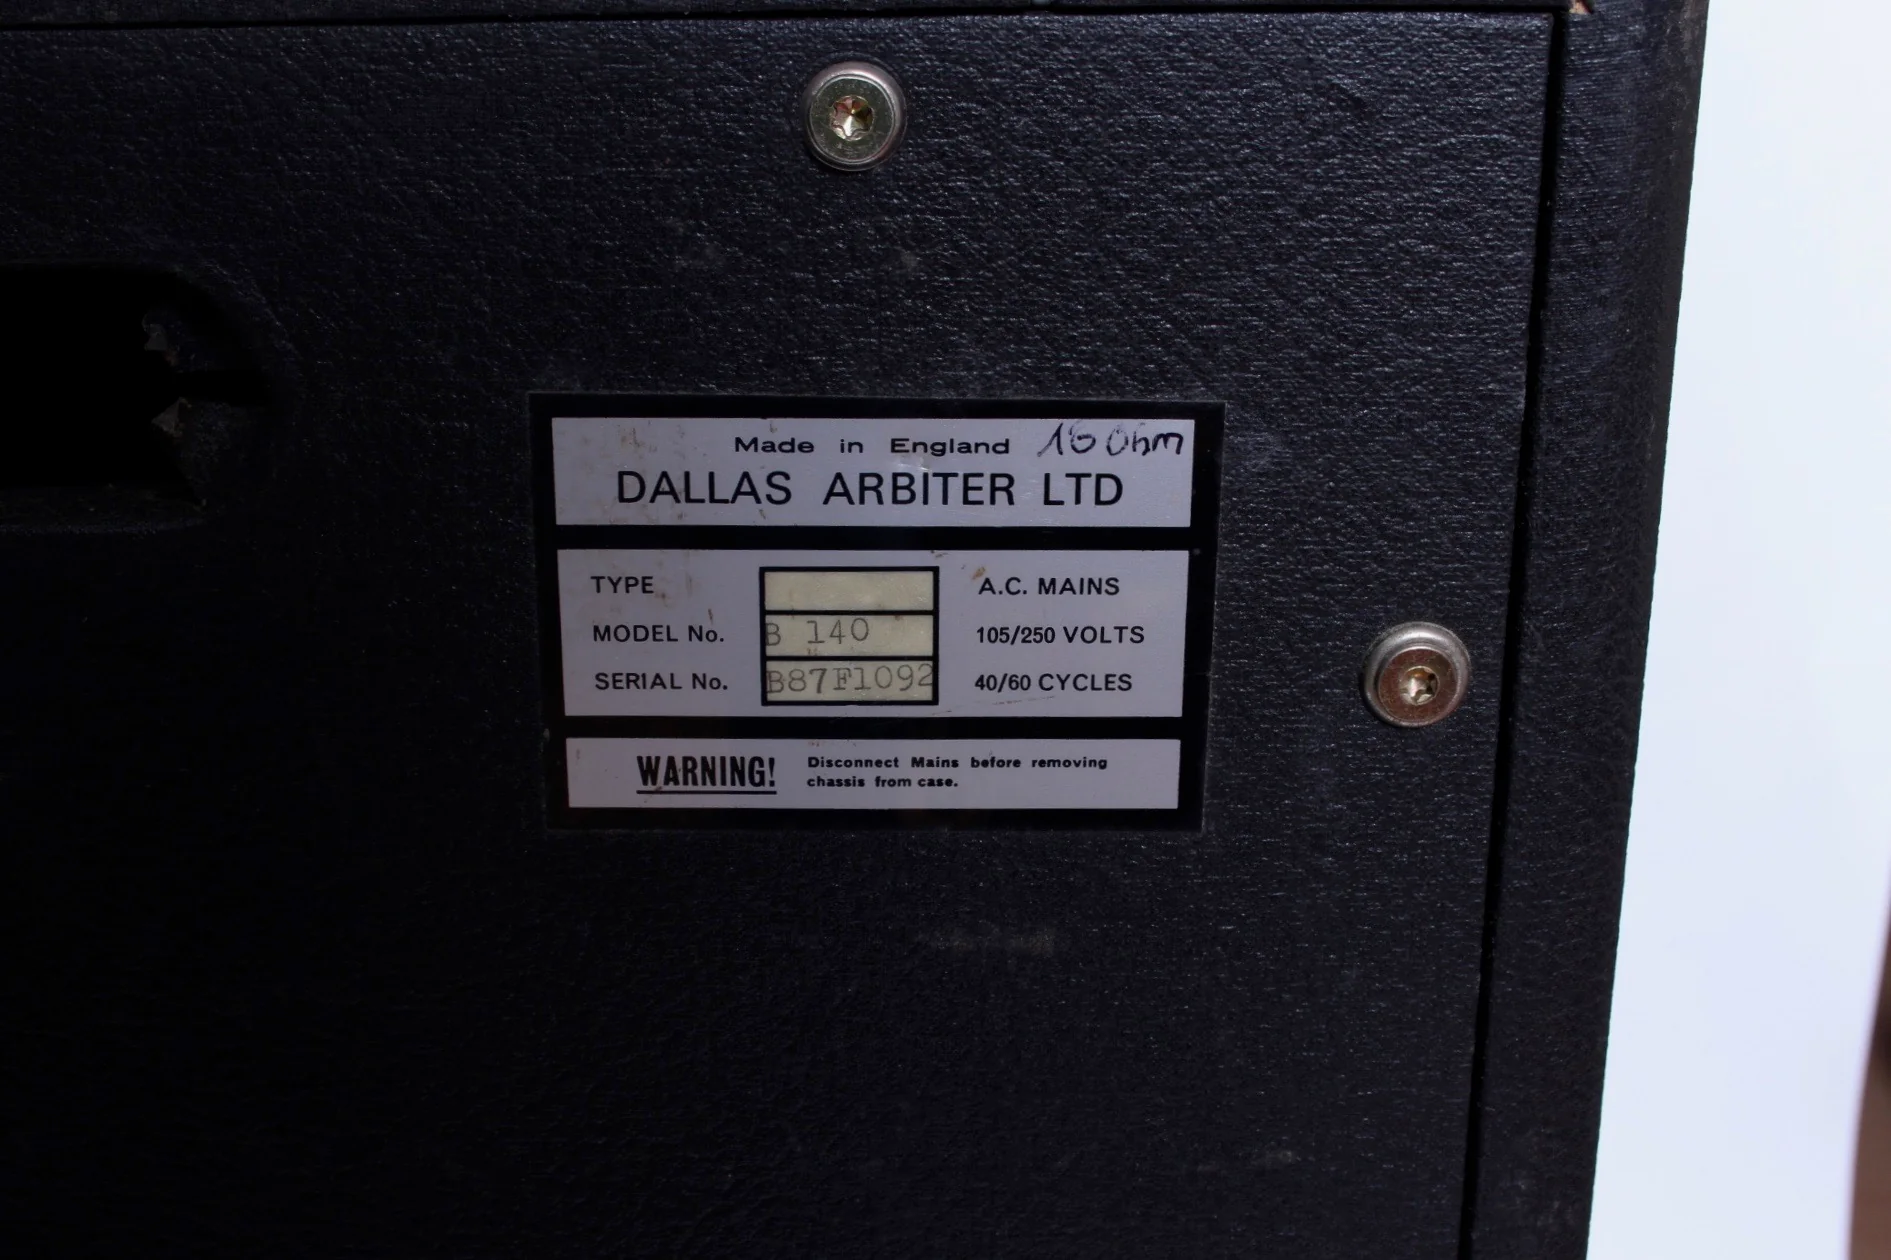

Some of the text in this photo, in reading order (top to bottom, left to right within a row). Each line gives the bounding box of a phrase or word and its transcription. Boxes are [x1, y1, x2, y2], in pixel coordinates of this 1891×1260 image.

[734, 436, 1010, 458] Made in England
[1105, 422, 1184, 457] Ohm
[617, 470, 1124, 506] DALLAS ARBITER LTD
[590, 575, 655, 594] TYPE
[978, 576, 1120, 596] A.C. MAINS
[592, 624, 725, 643] MODEL No.
[765, 617, 870, 647] B 140
[976, 624, 1145, 646] 105/250 VOLTS
[594, 672, 728, 691] SERIAL No.
[974, 672, 1133, 694] 40/60 CYCLES
[636, 755, 776, 788] WARNING!
[807, 755, 1108, 771] Disconnect Mains before removing
[806, 775, 959, 788] chassis from case.
